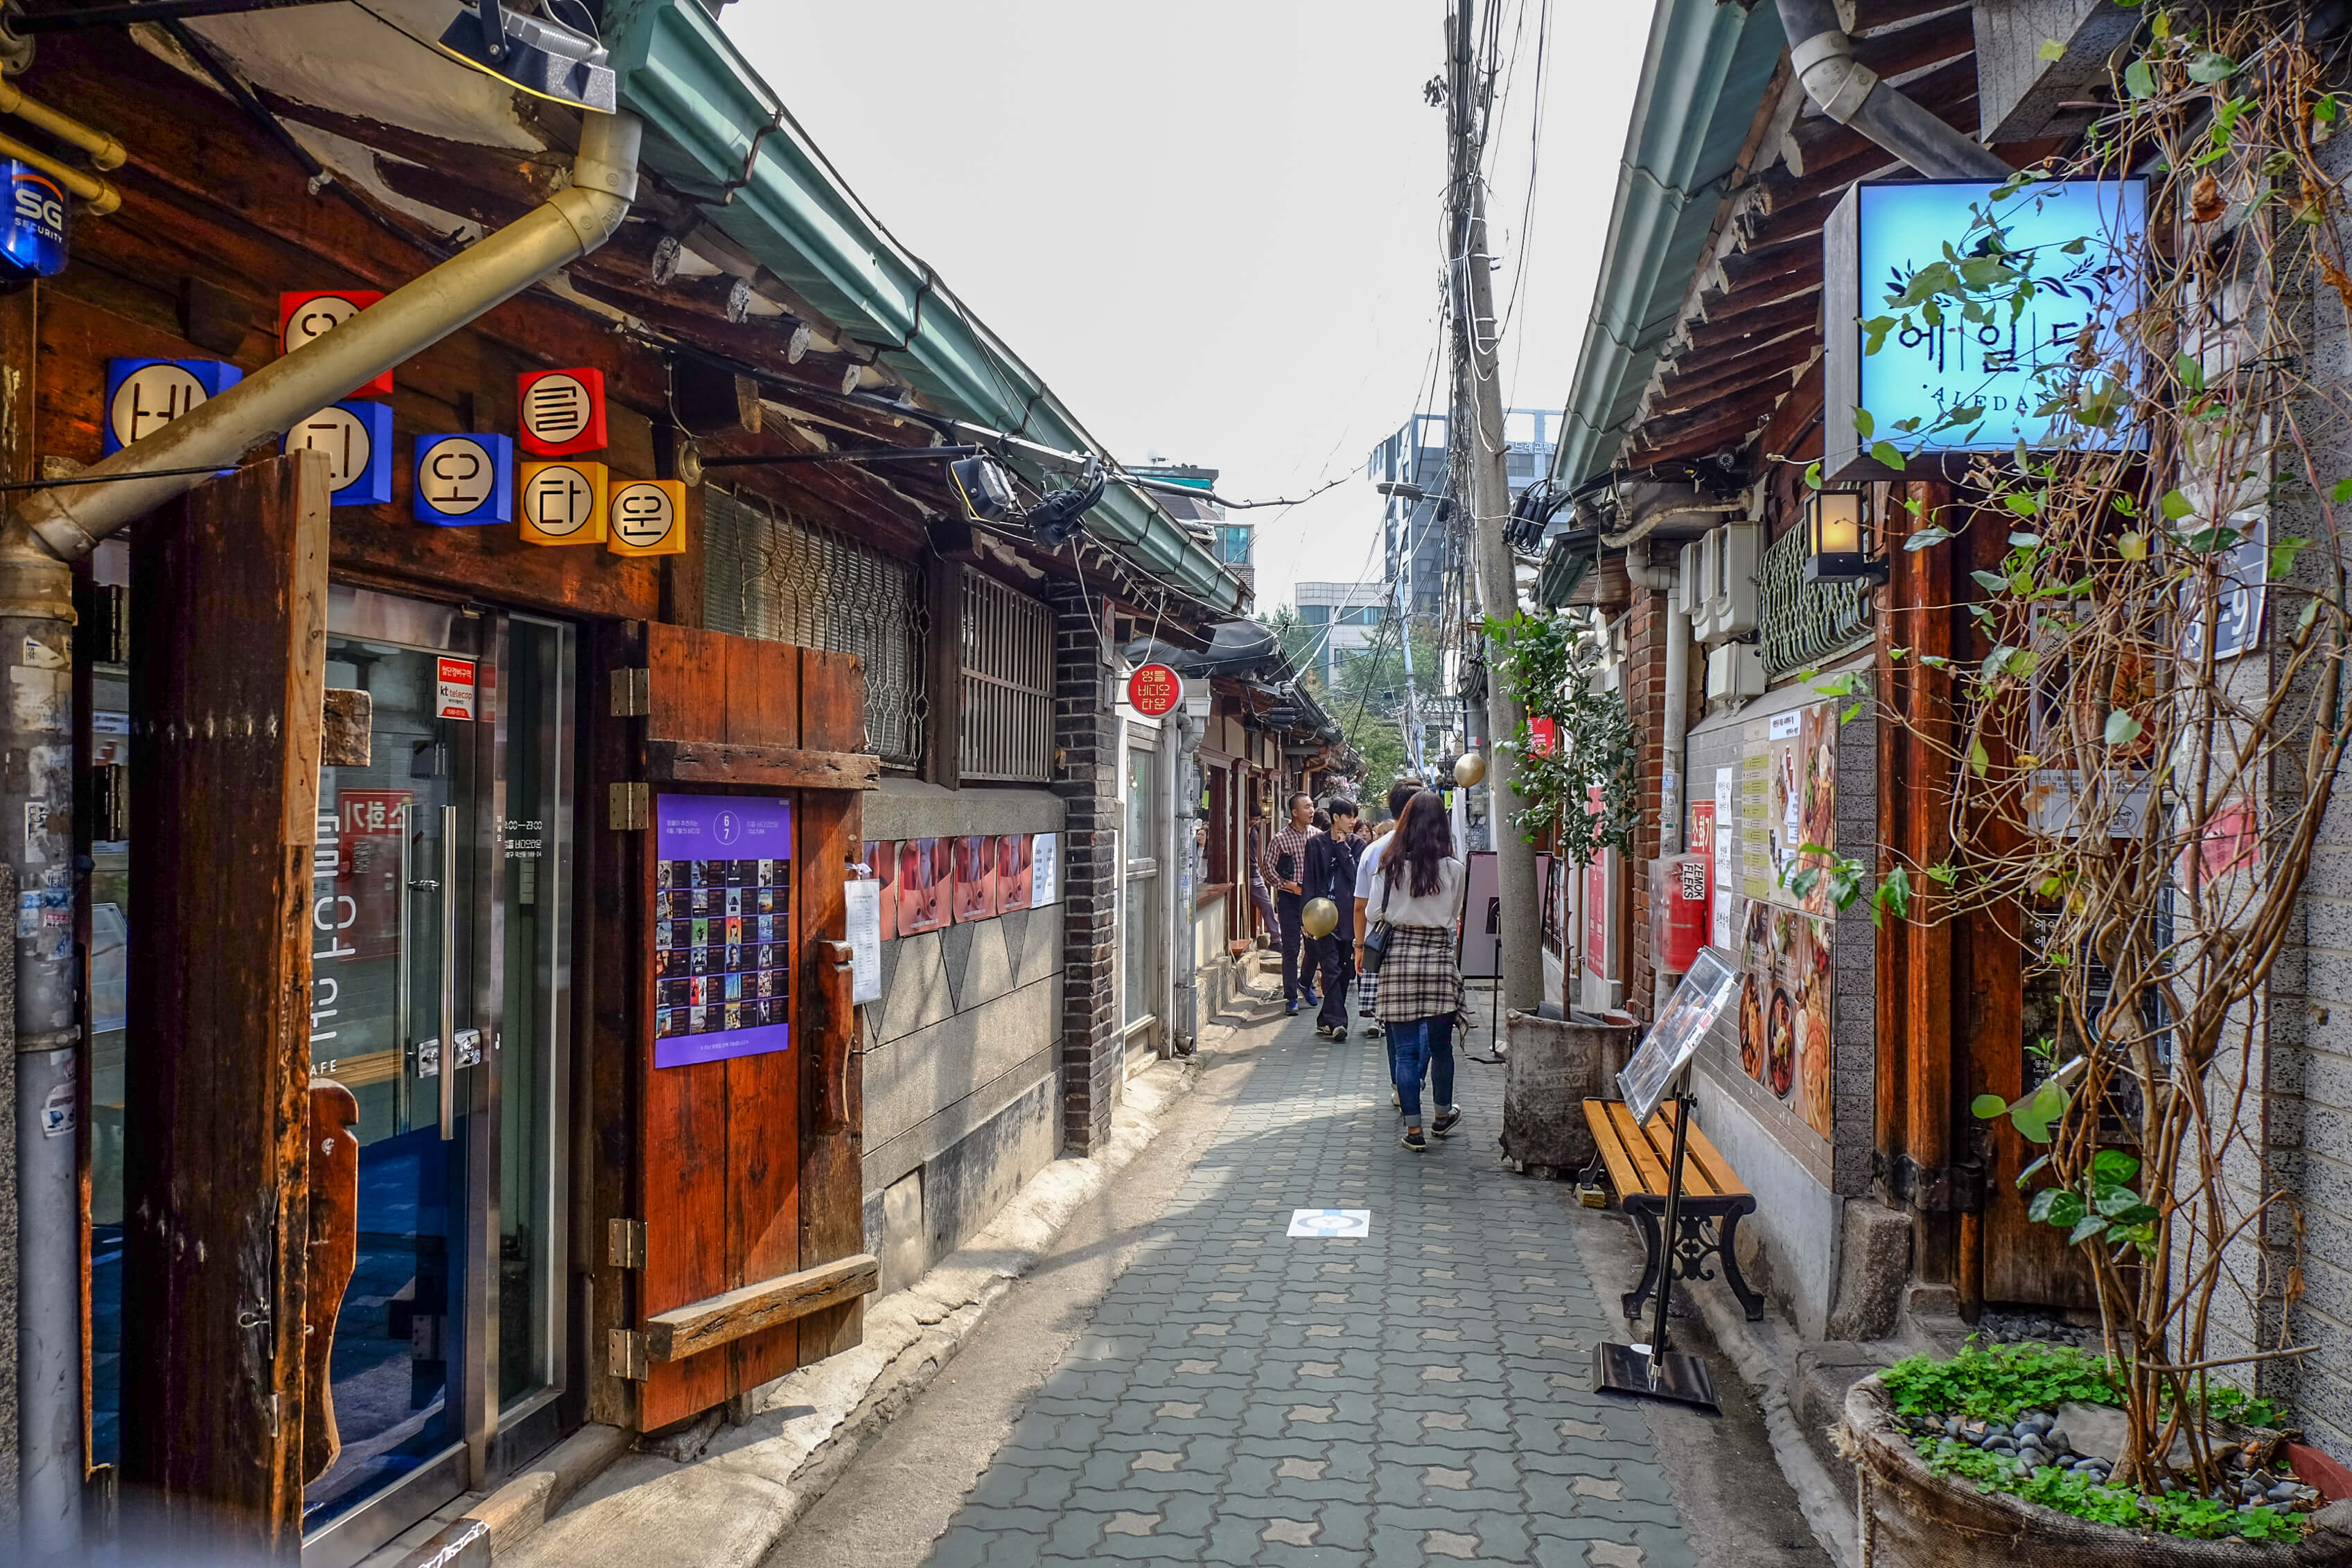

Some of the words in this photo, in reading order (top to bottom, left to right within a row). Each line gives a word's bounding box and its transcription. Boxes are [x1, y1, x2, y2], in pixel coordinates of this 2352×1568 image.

[15, 188, 62, 231] SG
[15, 217, 63, 244] SECURITY
[440, 685, 449, 696] kt
[449, 689, 473, 701] telecop
[1138, 684, 1170, 696] 비디오
[1141, 698, 1166, 710] 타운
[723, 816, 730, 827] 6
[723, 829, 730, 840] 7
[1691, 814, 1713, 854] 소화기
[1683, 864, 1694, 899] FLEKS
[1694, 864, 1703, 899] ZEMOK
